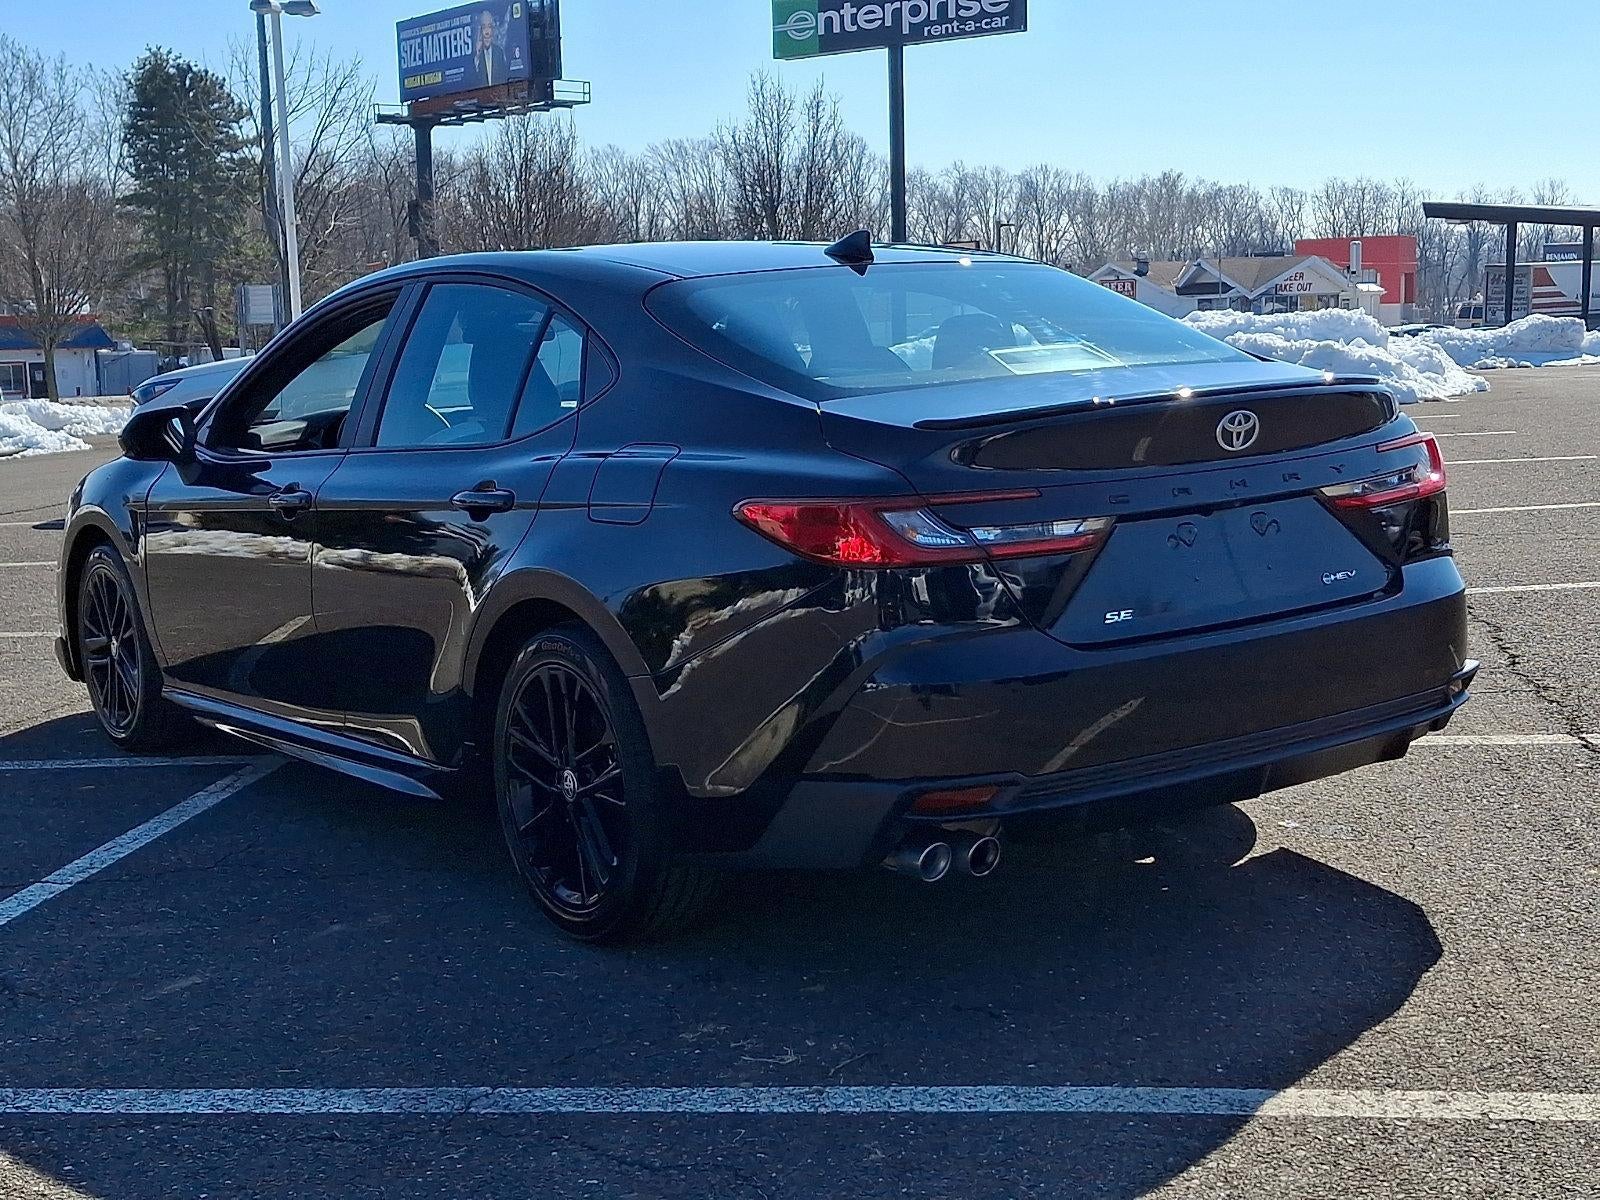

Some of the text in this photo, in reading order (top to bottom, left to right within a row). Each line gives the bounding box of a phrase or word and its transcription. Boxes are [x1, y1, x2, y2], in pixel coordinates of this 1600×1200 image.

[773, 0, 1009, 40] enterprise
[924, 14, 1009, 36] rent-a-car
[400, 26, 472, 69] SIZE MATTERS
[1284, 271, 1304, 281] EER
[1297, 282, 1312, 292] OUT
[1104, 610, 1134, 624] SE
